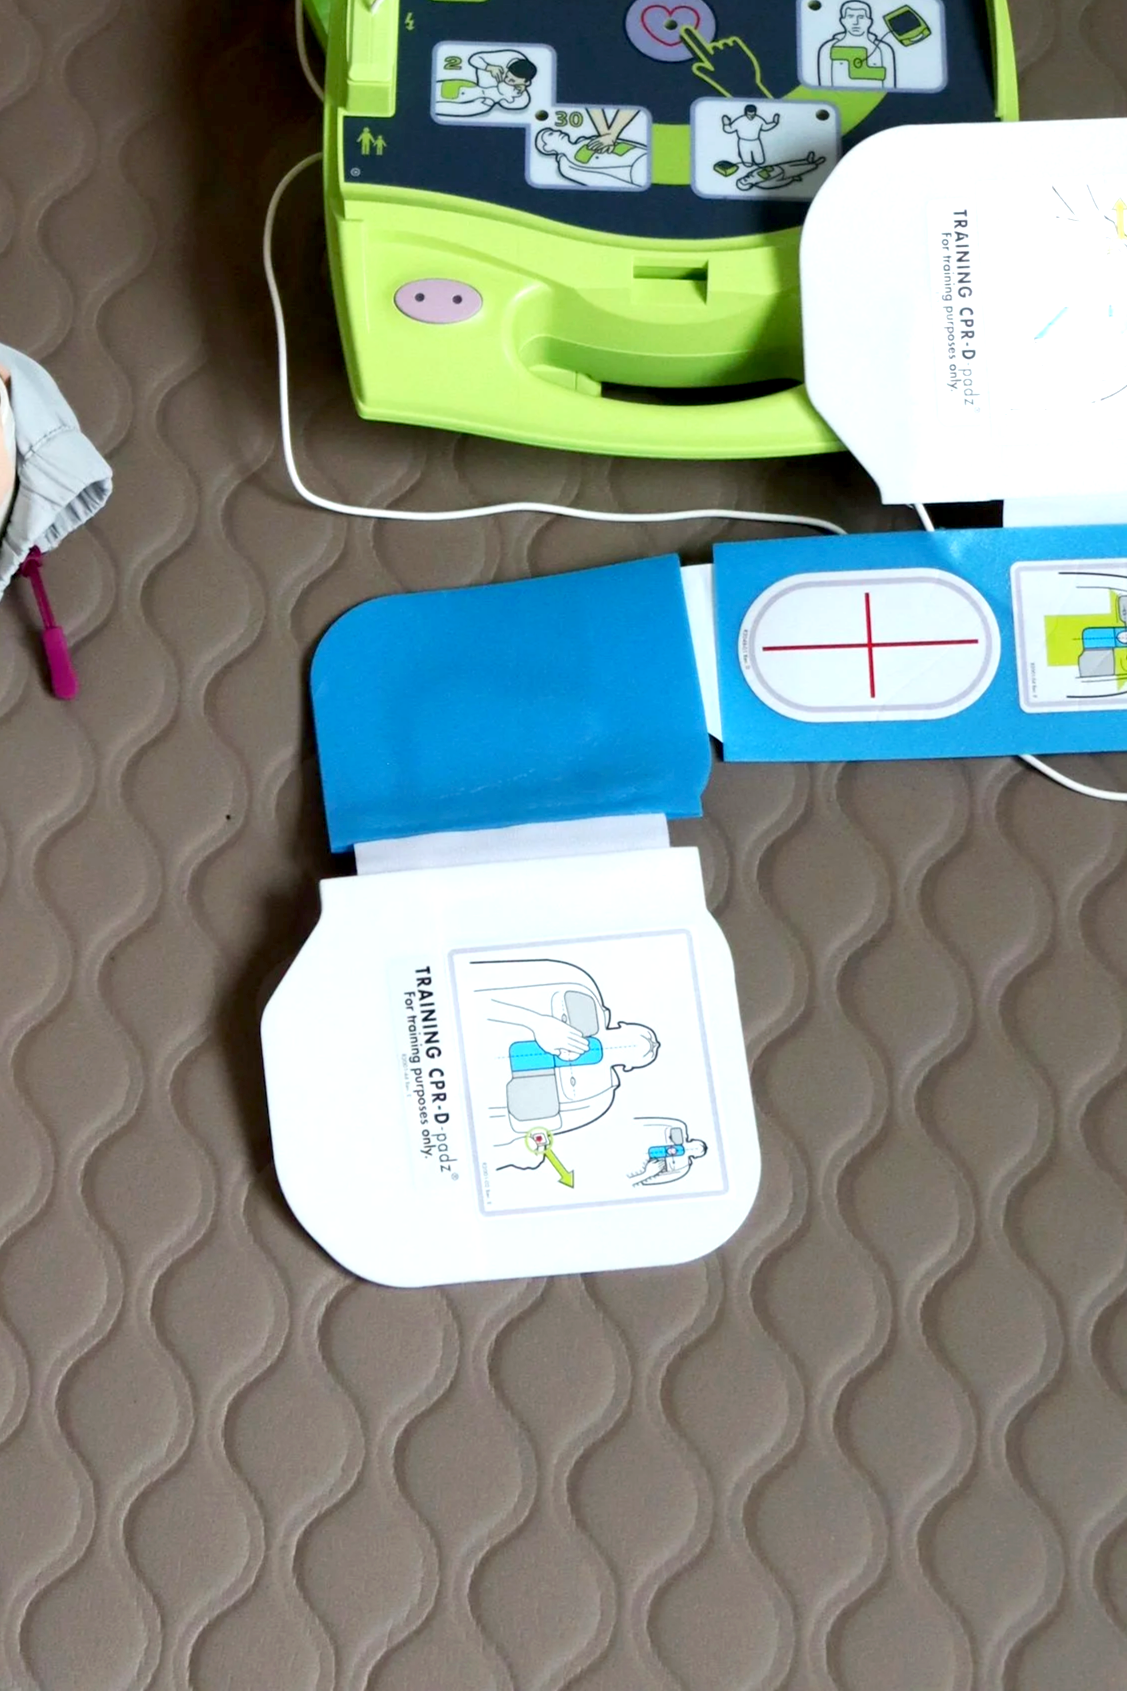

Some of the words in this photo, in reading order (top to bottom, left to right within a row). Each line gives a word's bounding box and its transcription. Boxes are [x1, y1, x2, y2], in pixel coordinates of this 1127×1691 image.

[443, 55, 462, 71] 2
[555, 111, 584, 128] 30
[941, 232, 953, 251] For
[953, 209, 973, 299] TRAINING
[942, 255, 955, 302] training
[943, 306, 957, 360] purposes
[946, 364, 961, 392] only.
[404, 991, 416, 1012] For
[415, 966, 442, 1060] TRAINING
[408, 1015, 423, 1064] training
[411, 1068, 430, 1125] purposes
[421, 1129, 436, 1160] only.
